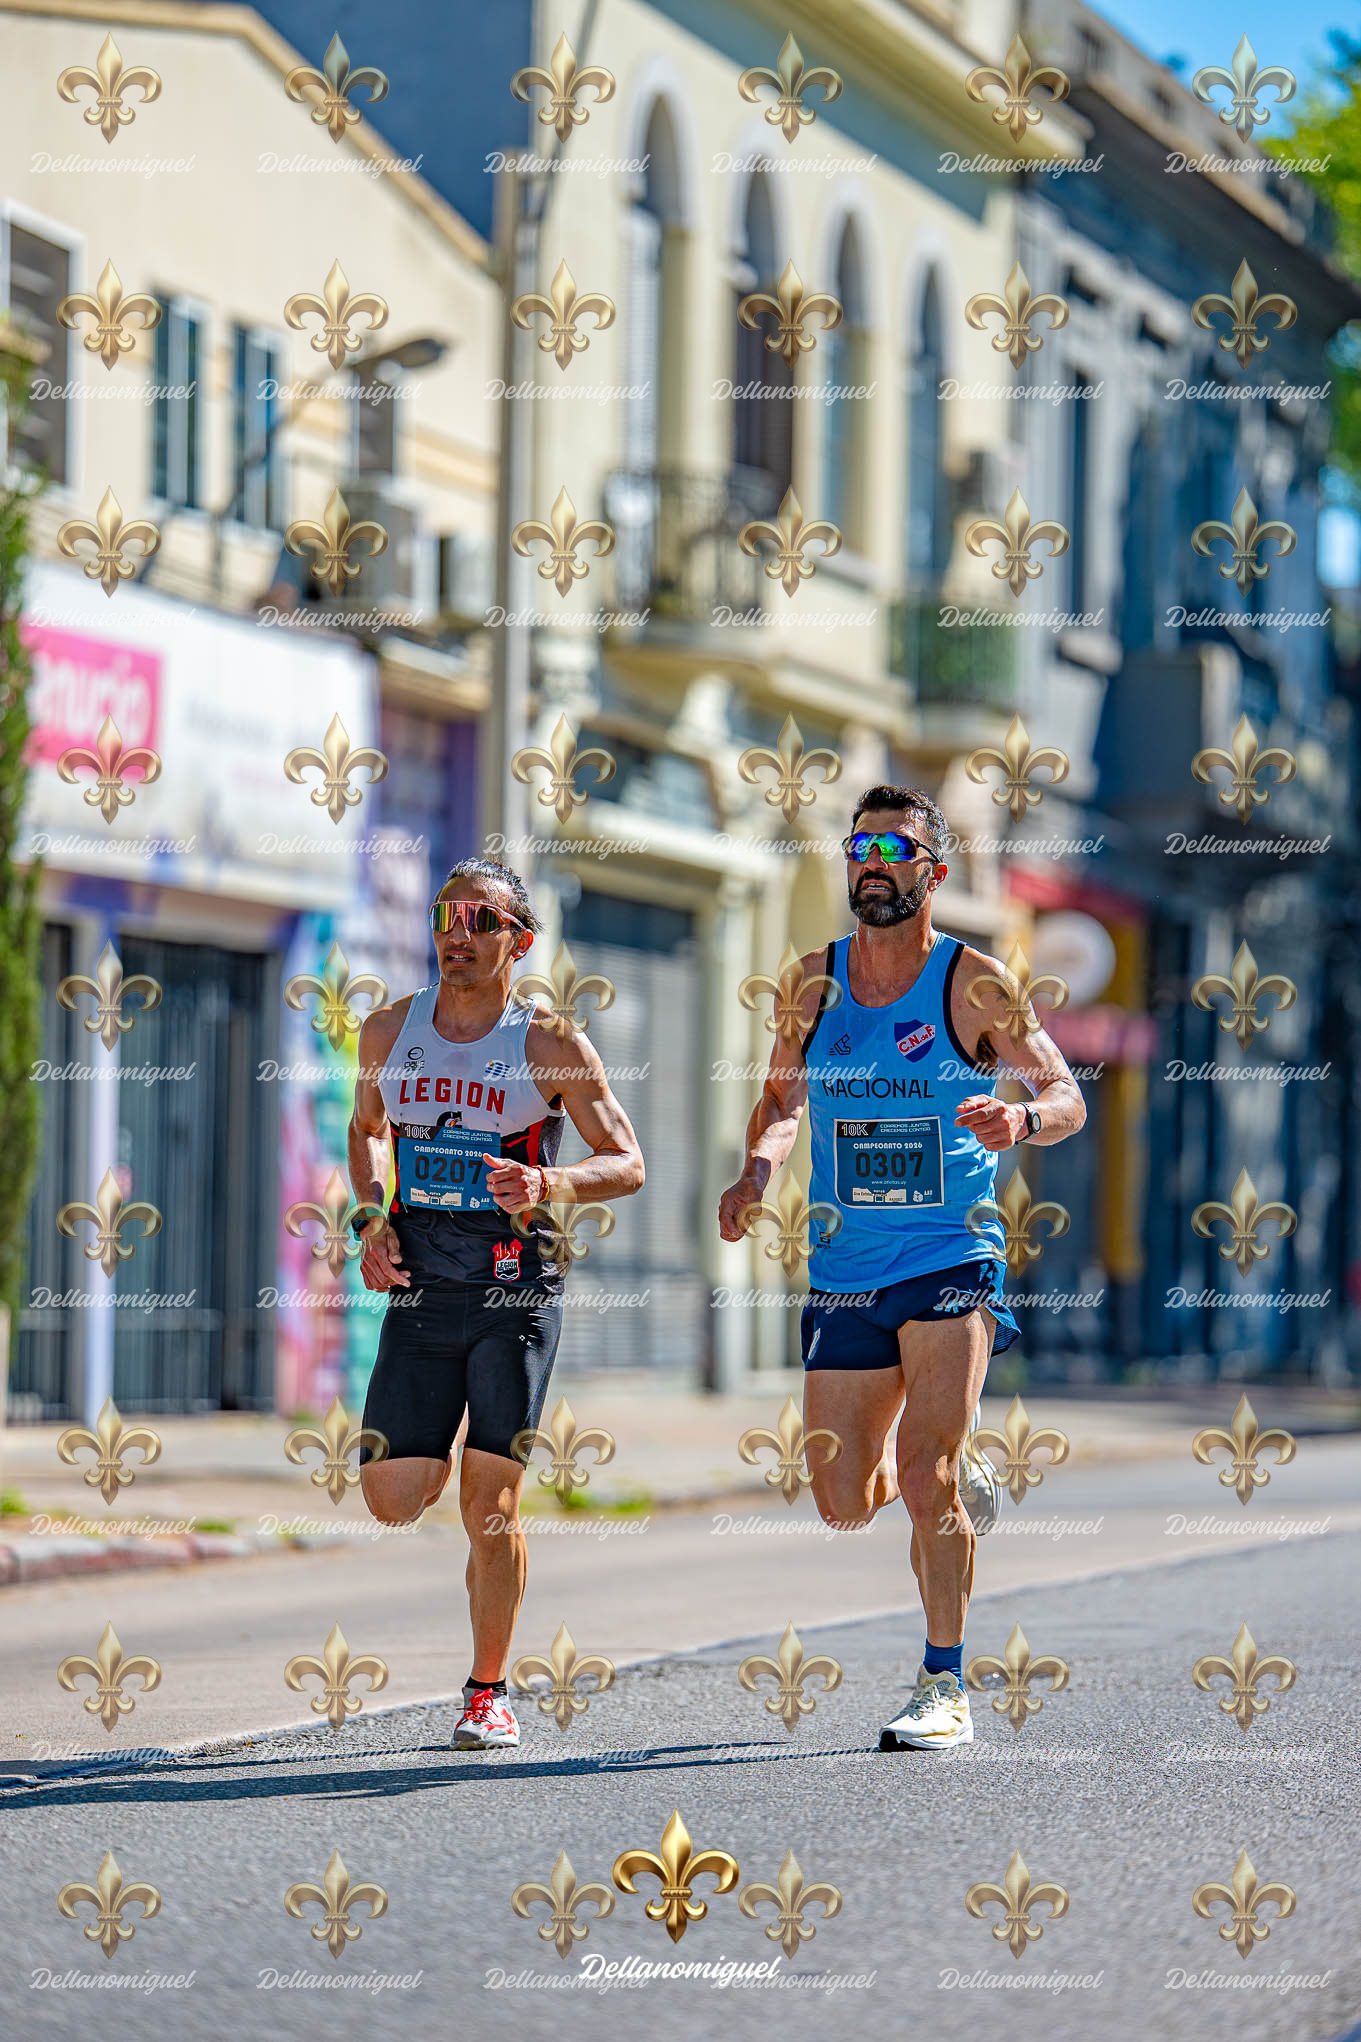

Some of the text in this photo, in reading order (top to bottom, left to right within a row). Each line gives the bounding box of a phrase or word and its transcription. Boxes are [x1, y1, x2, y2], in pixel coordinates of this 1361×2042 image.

[400, 1077, 506, 1115] LEGION
[822, 1078, 935, 1099] NACIONAL
[404, 1124, 432, 1140] 10K
[841, 1123, 869, 1136] 10K
[414, 1145, 483, 1158] CAMPEONATO 2026
[415, 1155, 483, 1185] 0207
[856, 1151, 924, 1178] 0307
